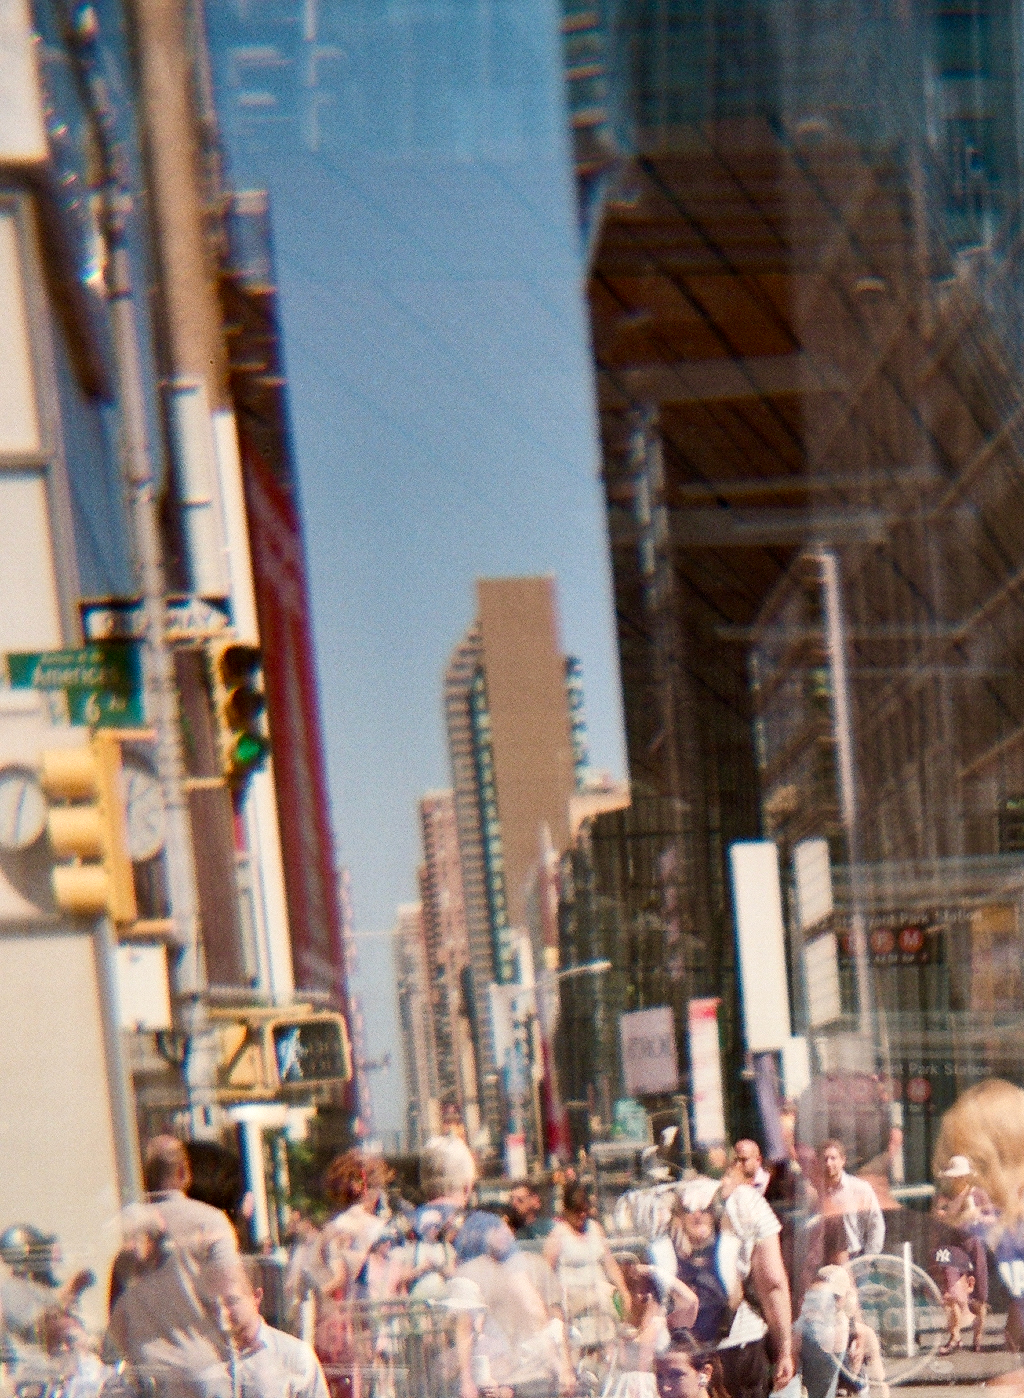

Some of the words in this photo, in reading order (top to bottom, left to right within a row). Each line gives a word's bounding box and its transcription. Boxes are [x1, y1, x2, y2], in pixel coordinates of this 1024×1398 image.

[84, 693, 102, 726] 6
[903, 931, 920, 948] M
[908, 1063, 939, 1077] Park
